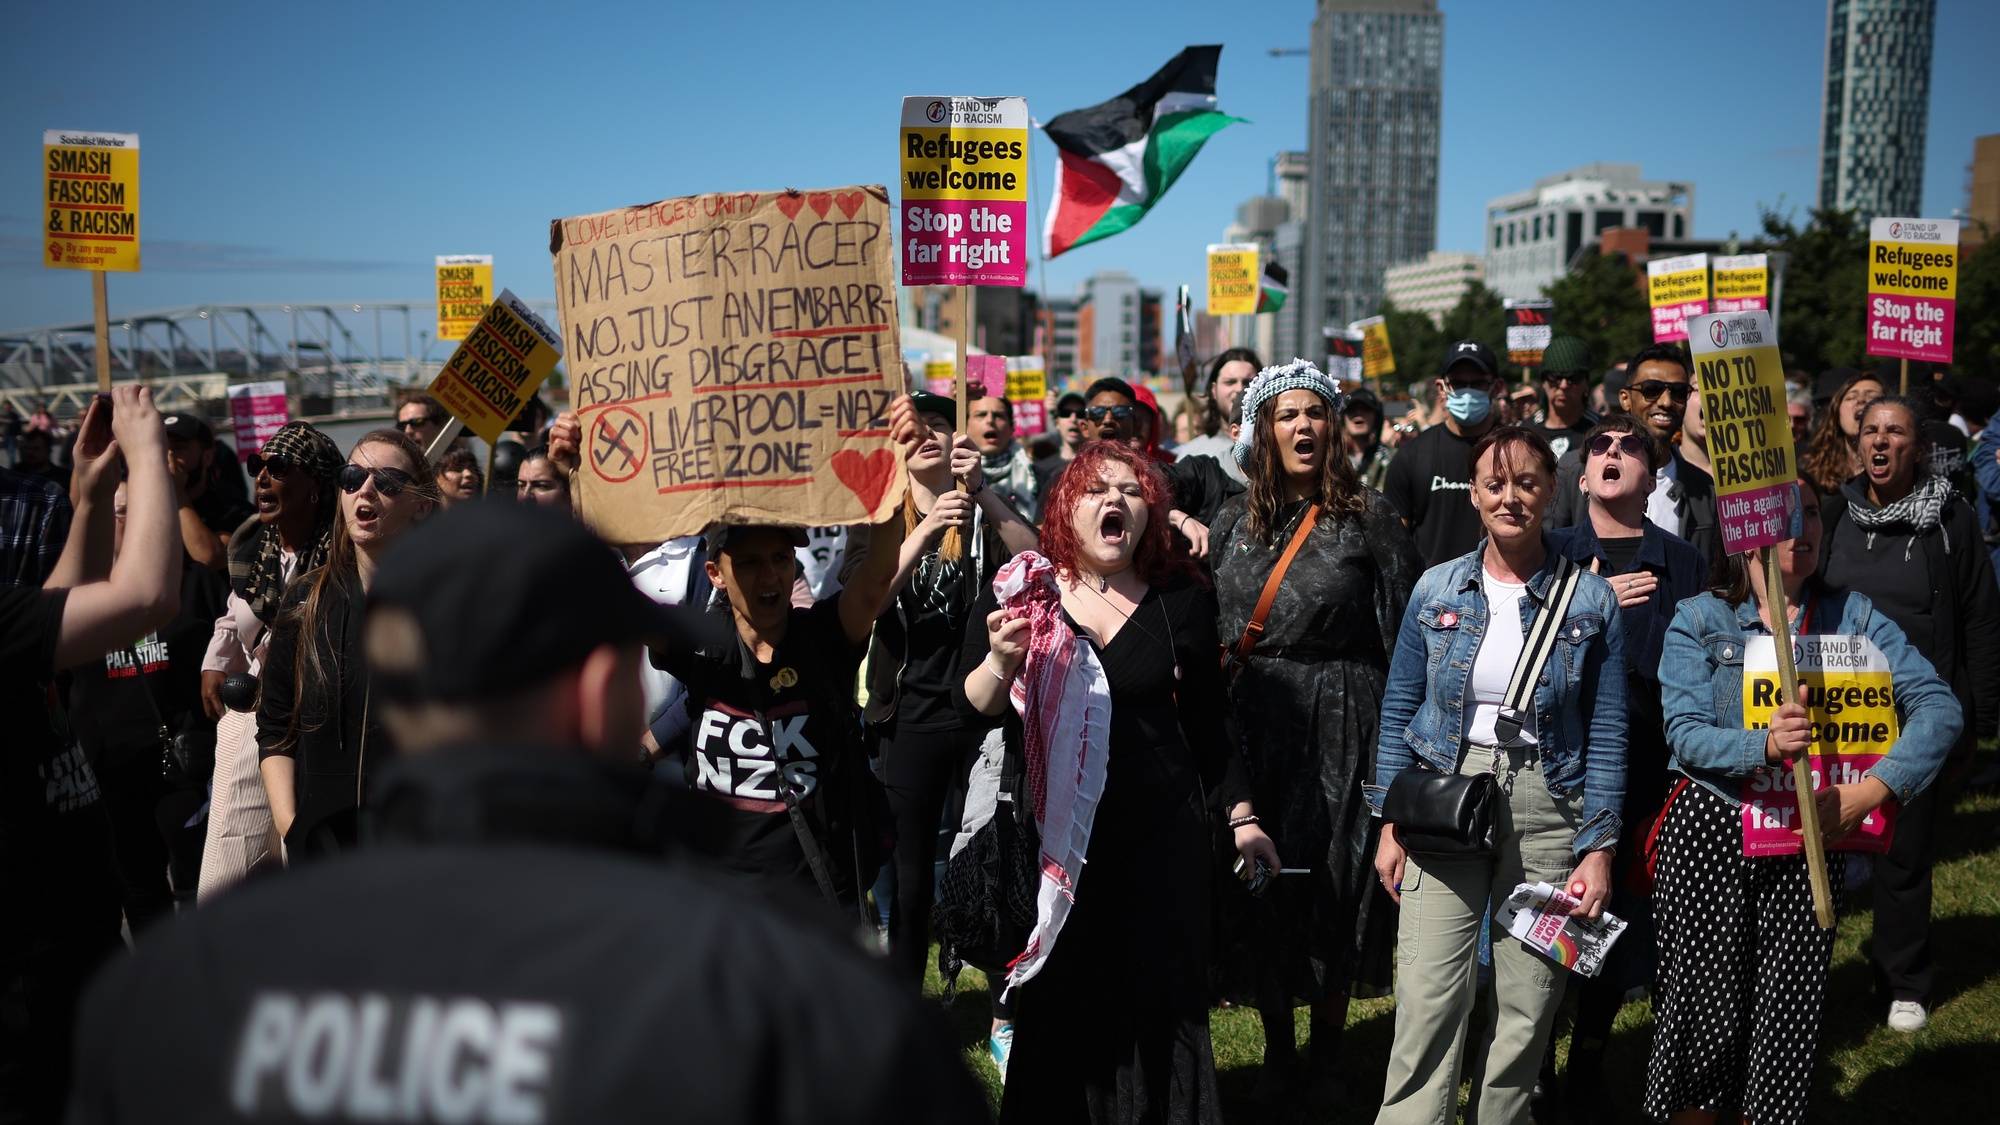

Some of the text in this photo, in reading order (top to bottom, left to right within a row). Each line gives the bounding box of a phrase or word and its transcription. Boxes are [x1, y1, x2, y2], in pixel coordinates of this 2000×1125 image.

[948, 101, 998, 113] STAND UP
[949, 113, 1002, 124] TO RACISM
[60, 135, 126, 147] Socialist Worker
[907, 133, 1023, 166] Refugees
[48, 149, 111, 174] SMASH
[907, 165, 1017, 190] welcome
[49, 179, 125, 205] FASCISM
[49, 209, 134, 235] & RACISM
[565, 213, 621, 246] LOVE,
[624, 201, 685, 235] PEACE
[703, 193, 760, 218] UNITY
[907, 206, 1012, 238] Stop the
[1903, 223, 1938, 232] STAND UP
[1903, 232, 1941, 241] TO RACISM
[66, 254, 105, 266] necessary
[78, 245, 92, 255] any
[93, 245, 117, 254] means
[908, 238, 1010, 269] far right
[1875, 245, 1953, 270] Refugees
[438, 267, 474, 280] SMASH
[1653, 273, 1704, 288] Refugees
[1717, 270, 1764, 283] Refugees
[1875, 269, 1948, 291] welcome
[440, 286, 483, 299] FASCISM
[1654, 287, 1702, 301] welcome
[1717, 283, 1762, 294] welcome
[1681, 304, 1703, 316] the
[1873, 298, 1945, 324] Stop the
[487, 305, 539, 357] SMASH
[575, 316, 626, 363] NO,
[627, 296, 714, 352] JUST
[723, 289, 765, 338] AN
[1730, 331, 1762, 345] TO RACISM
[1872, 320, 1943, 348] far right
[468, 324, 531, 387] FASCISM
[451, 350, 521, 416] & RACISM
[578, 334, 882, 408] ASSING DISGRACE!
[1700, 355, 1756, 391] NO TO
[1706, 385, 1776, 423] RACISM,
[1710, 418, 1766, 455] NO TO
[652, 442, 813, 489] FREE ZONE
[1716, 447, 1786, 488] FASCISM
[1431, 475, 1471, 491] Cham
[1721, 491, 1784, 519] Unite against
[1724, 515, 1784, 543] the far right
[105, 641, 170, 671] PALSTINE
[1807, 641, 1862, 654] STAND UP
[1807, 655, 1868, 668] TO RACISM
[696, 709, 820, 760] FCK
[696, 750, 818, 801] NZS
[1750, 800, 1796, 830] far
[1541, 916, 1563, 946] NOT
[234, 992, 558, 1124] POLICE
